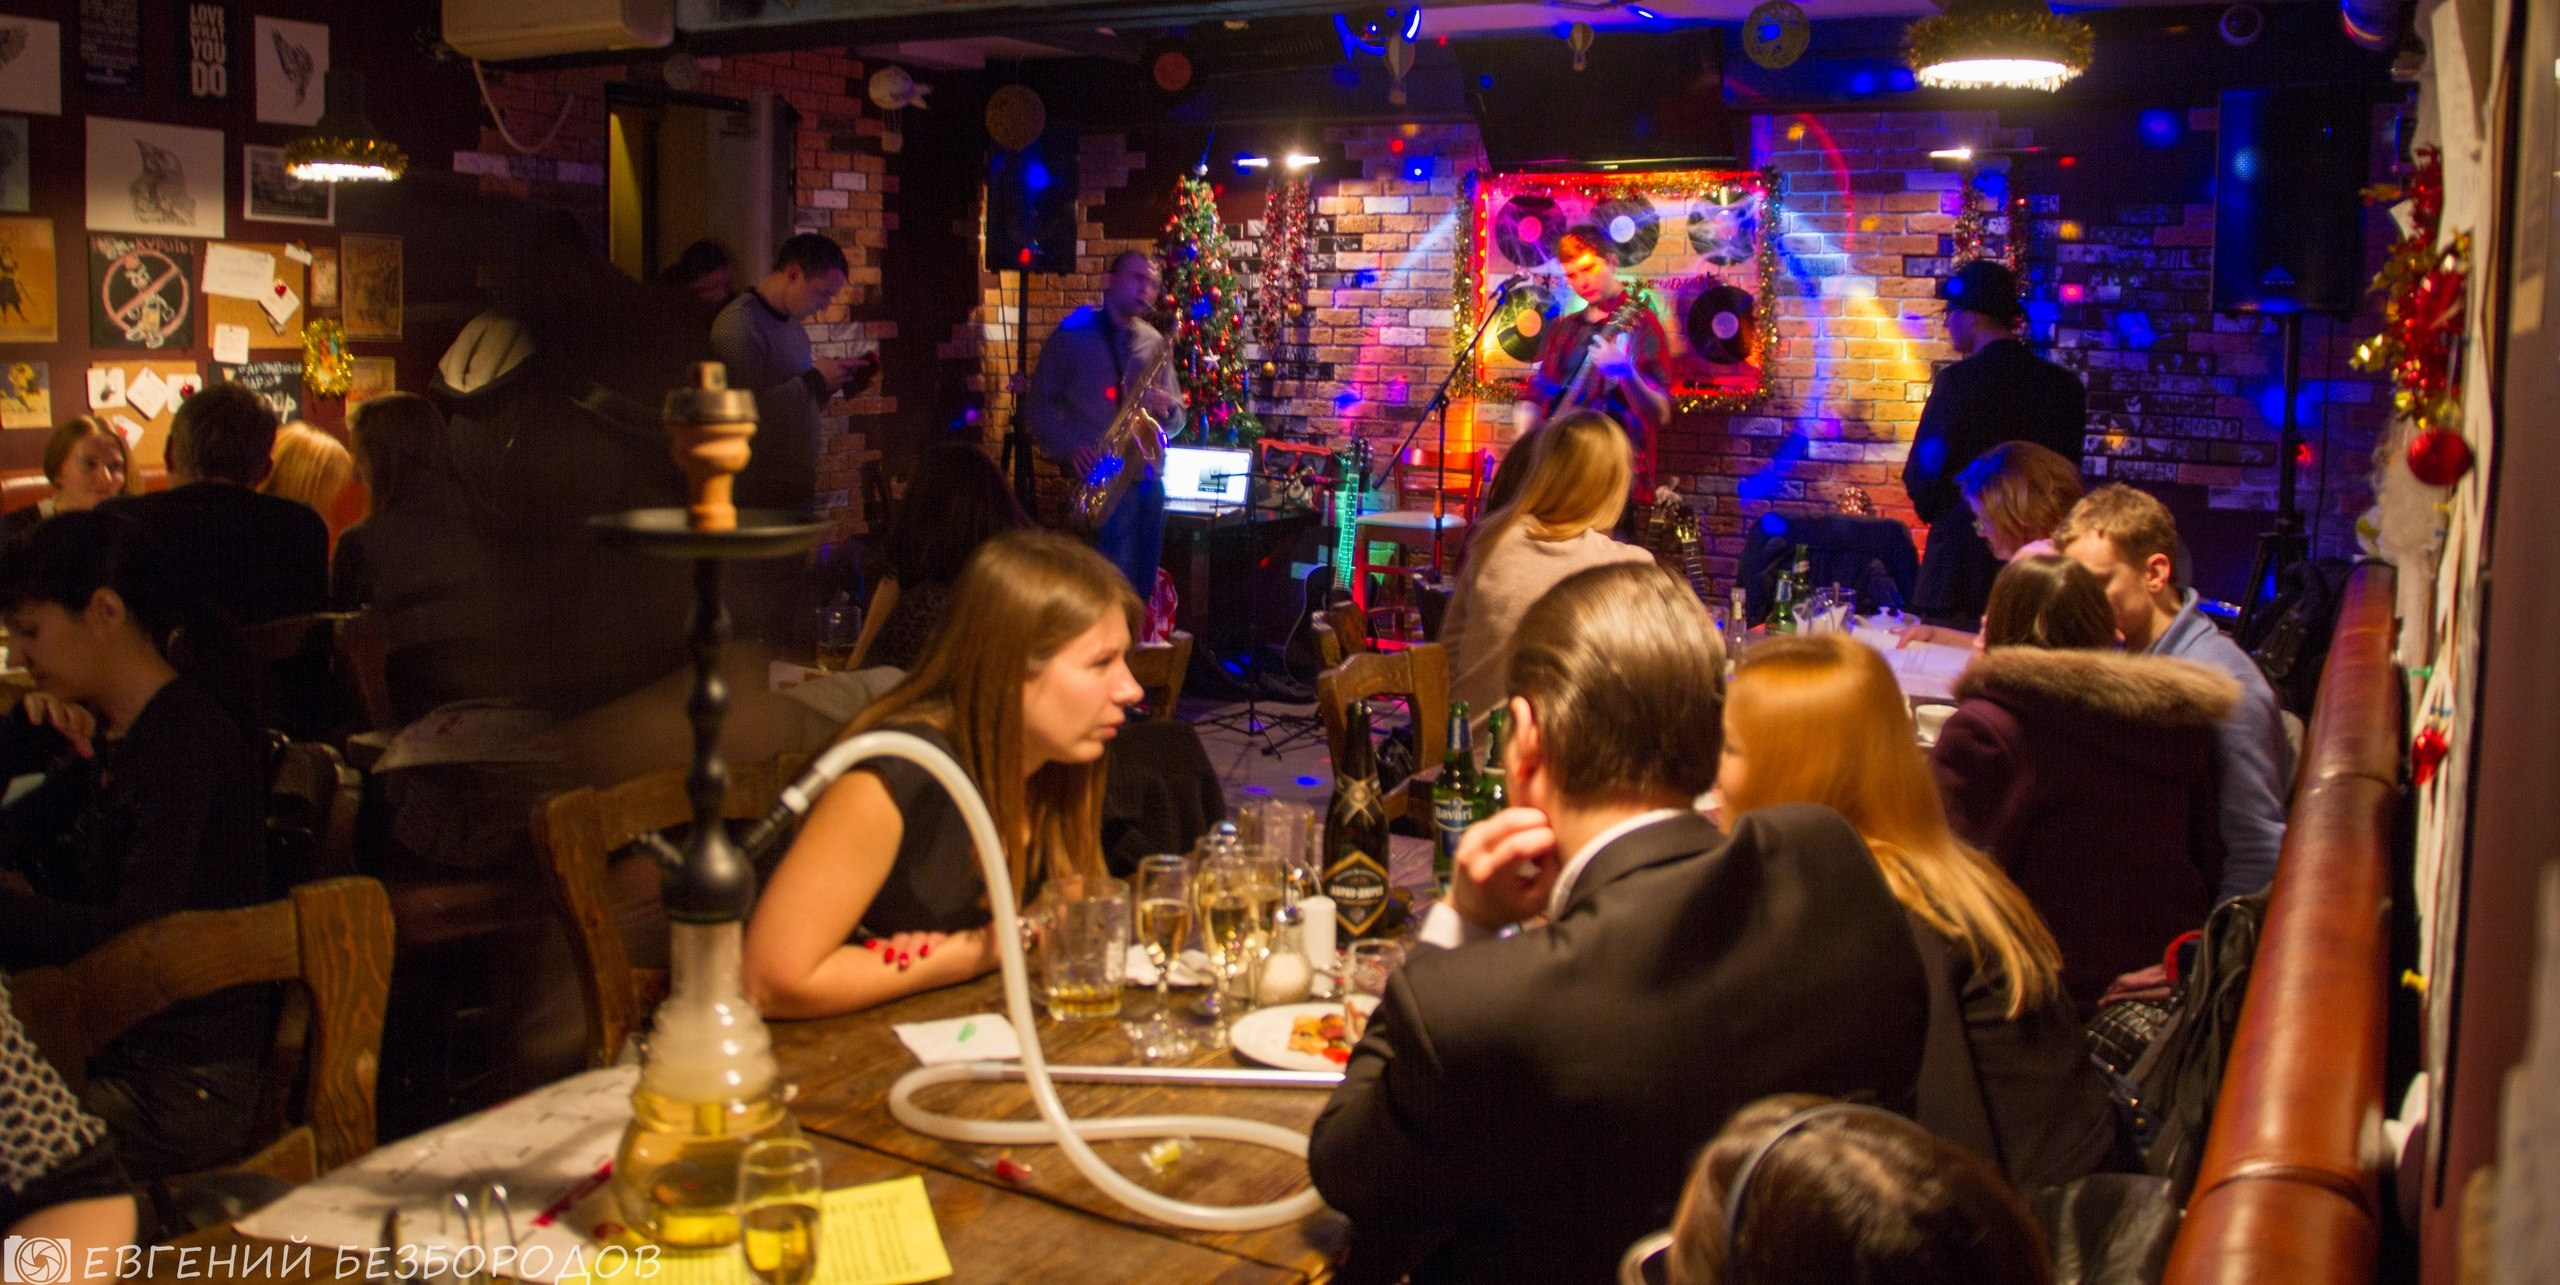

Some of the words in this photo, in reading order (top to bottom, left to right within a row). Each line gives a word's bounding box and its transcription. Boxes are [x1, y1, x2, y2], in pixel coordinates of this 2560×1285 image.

[190, 3, 224, 25] LOVE
[190, 37, 226, 63] YOU
[191, 60, 226, 97] DO
